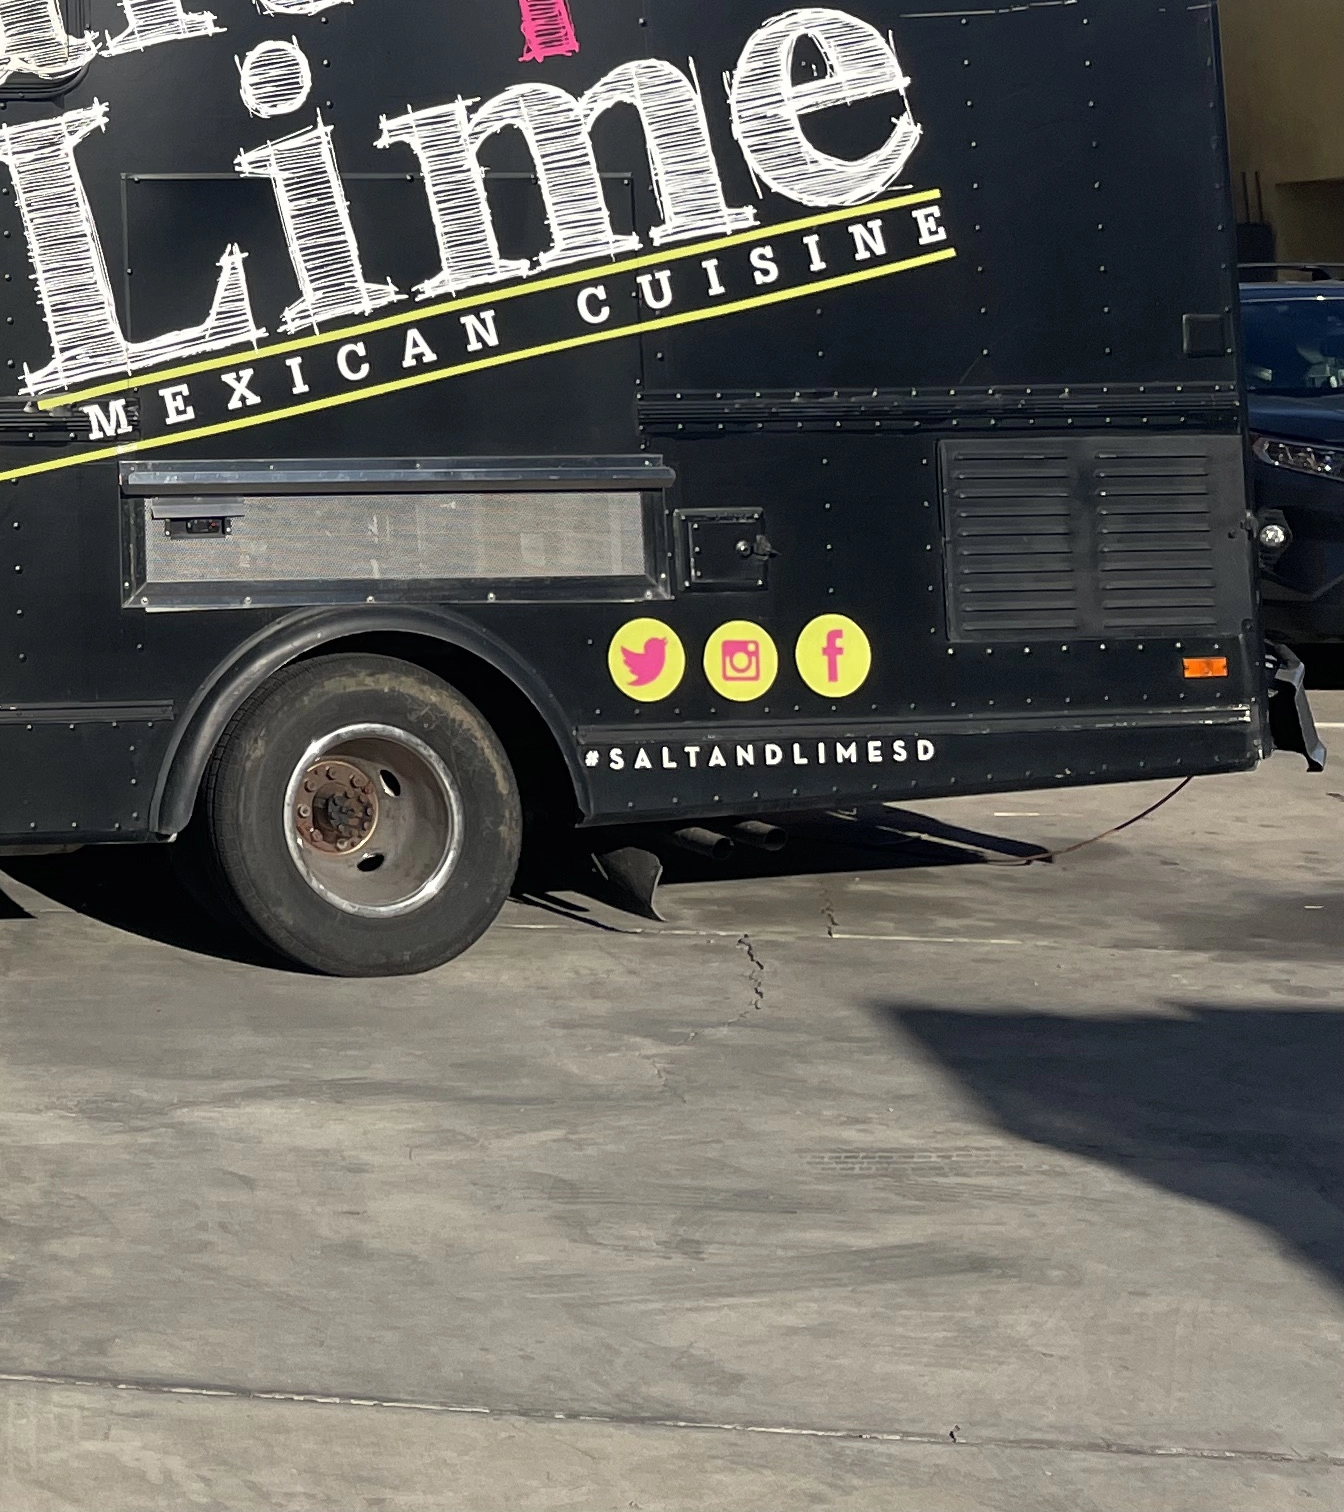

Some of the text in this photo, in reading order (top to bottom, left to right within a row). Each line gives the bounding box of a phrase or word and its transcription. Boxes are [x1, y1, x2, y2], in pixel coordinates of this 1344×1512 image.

[82, 309, 500, 441] MEXICAN
[577, 206, 947, 324] CUISINE
[585, 739, 935, 770] #SALTANDLIMESD
